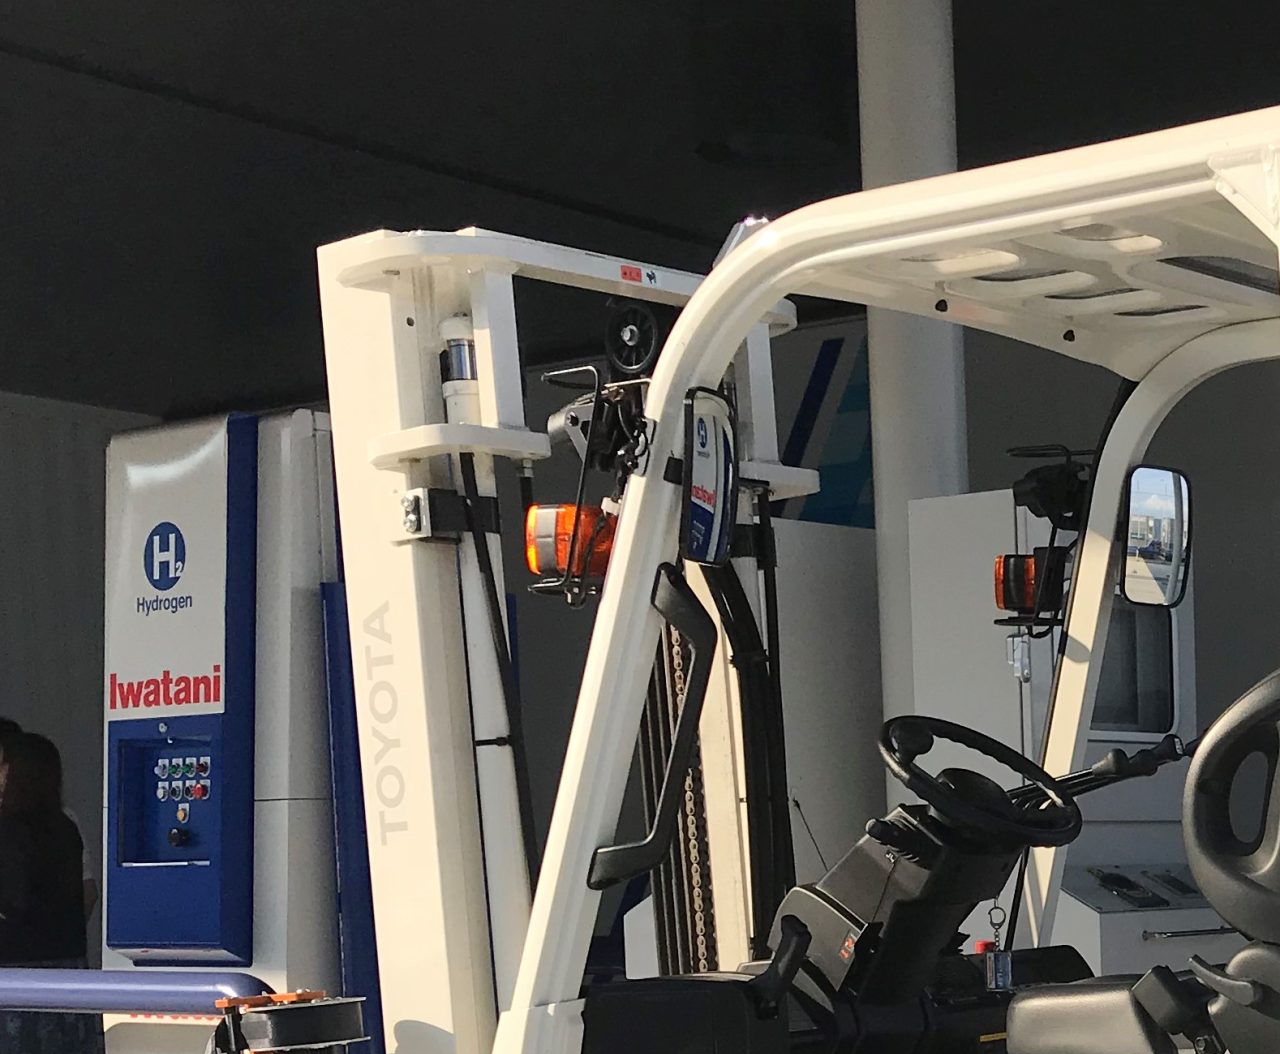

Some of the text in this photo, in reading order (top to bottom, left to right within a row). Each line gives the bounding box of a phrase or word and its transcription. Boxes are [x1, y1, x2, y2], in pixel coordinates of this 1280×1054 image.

[136, 595, 193, 617] Hydrogen
[109, 664, 221, 711] Iwatani
[362, 600, 409, 847] TOYOTA
